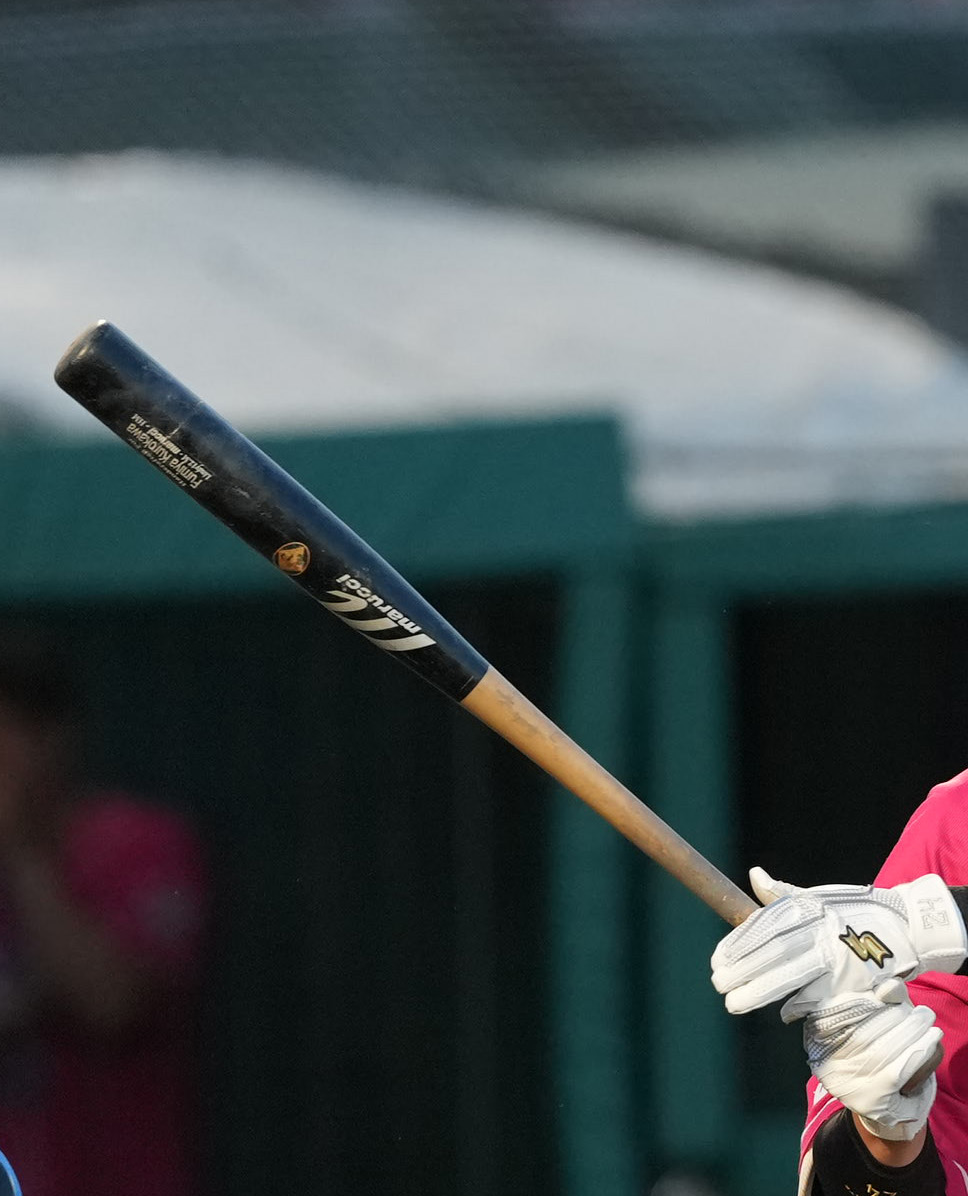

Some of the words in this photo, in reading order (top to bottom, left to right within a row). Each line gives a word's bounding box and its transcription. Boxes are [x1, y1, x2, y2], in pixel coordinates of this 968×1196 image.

[126, 422, 171, 463] Kurokawa
[169, 458, 203, 489] Fumiya
[336, 573, 423, 635] marucci
